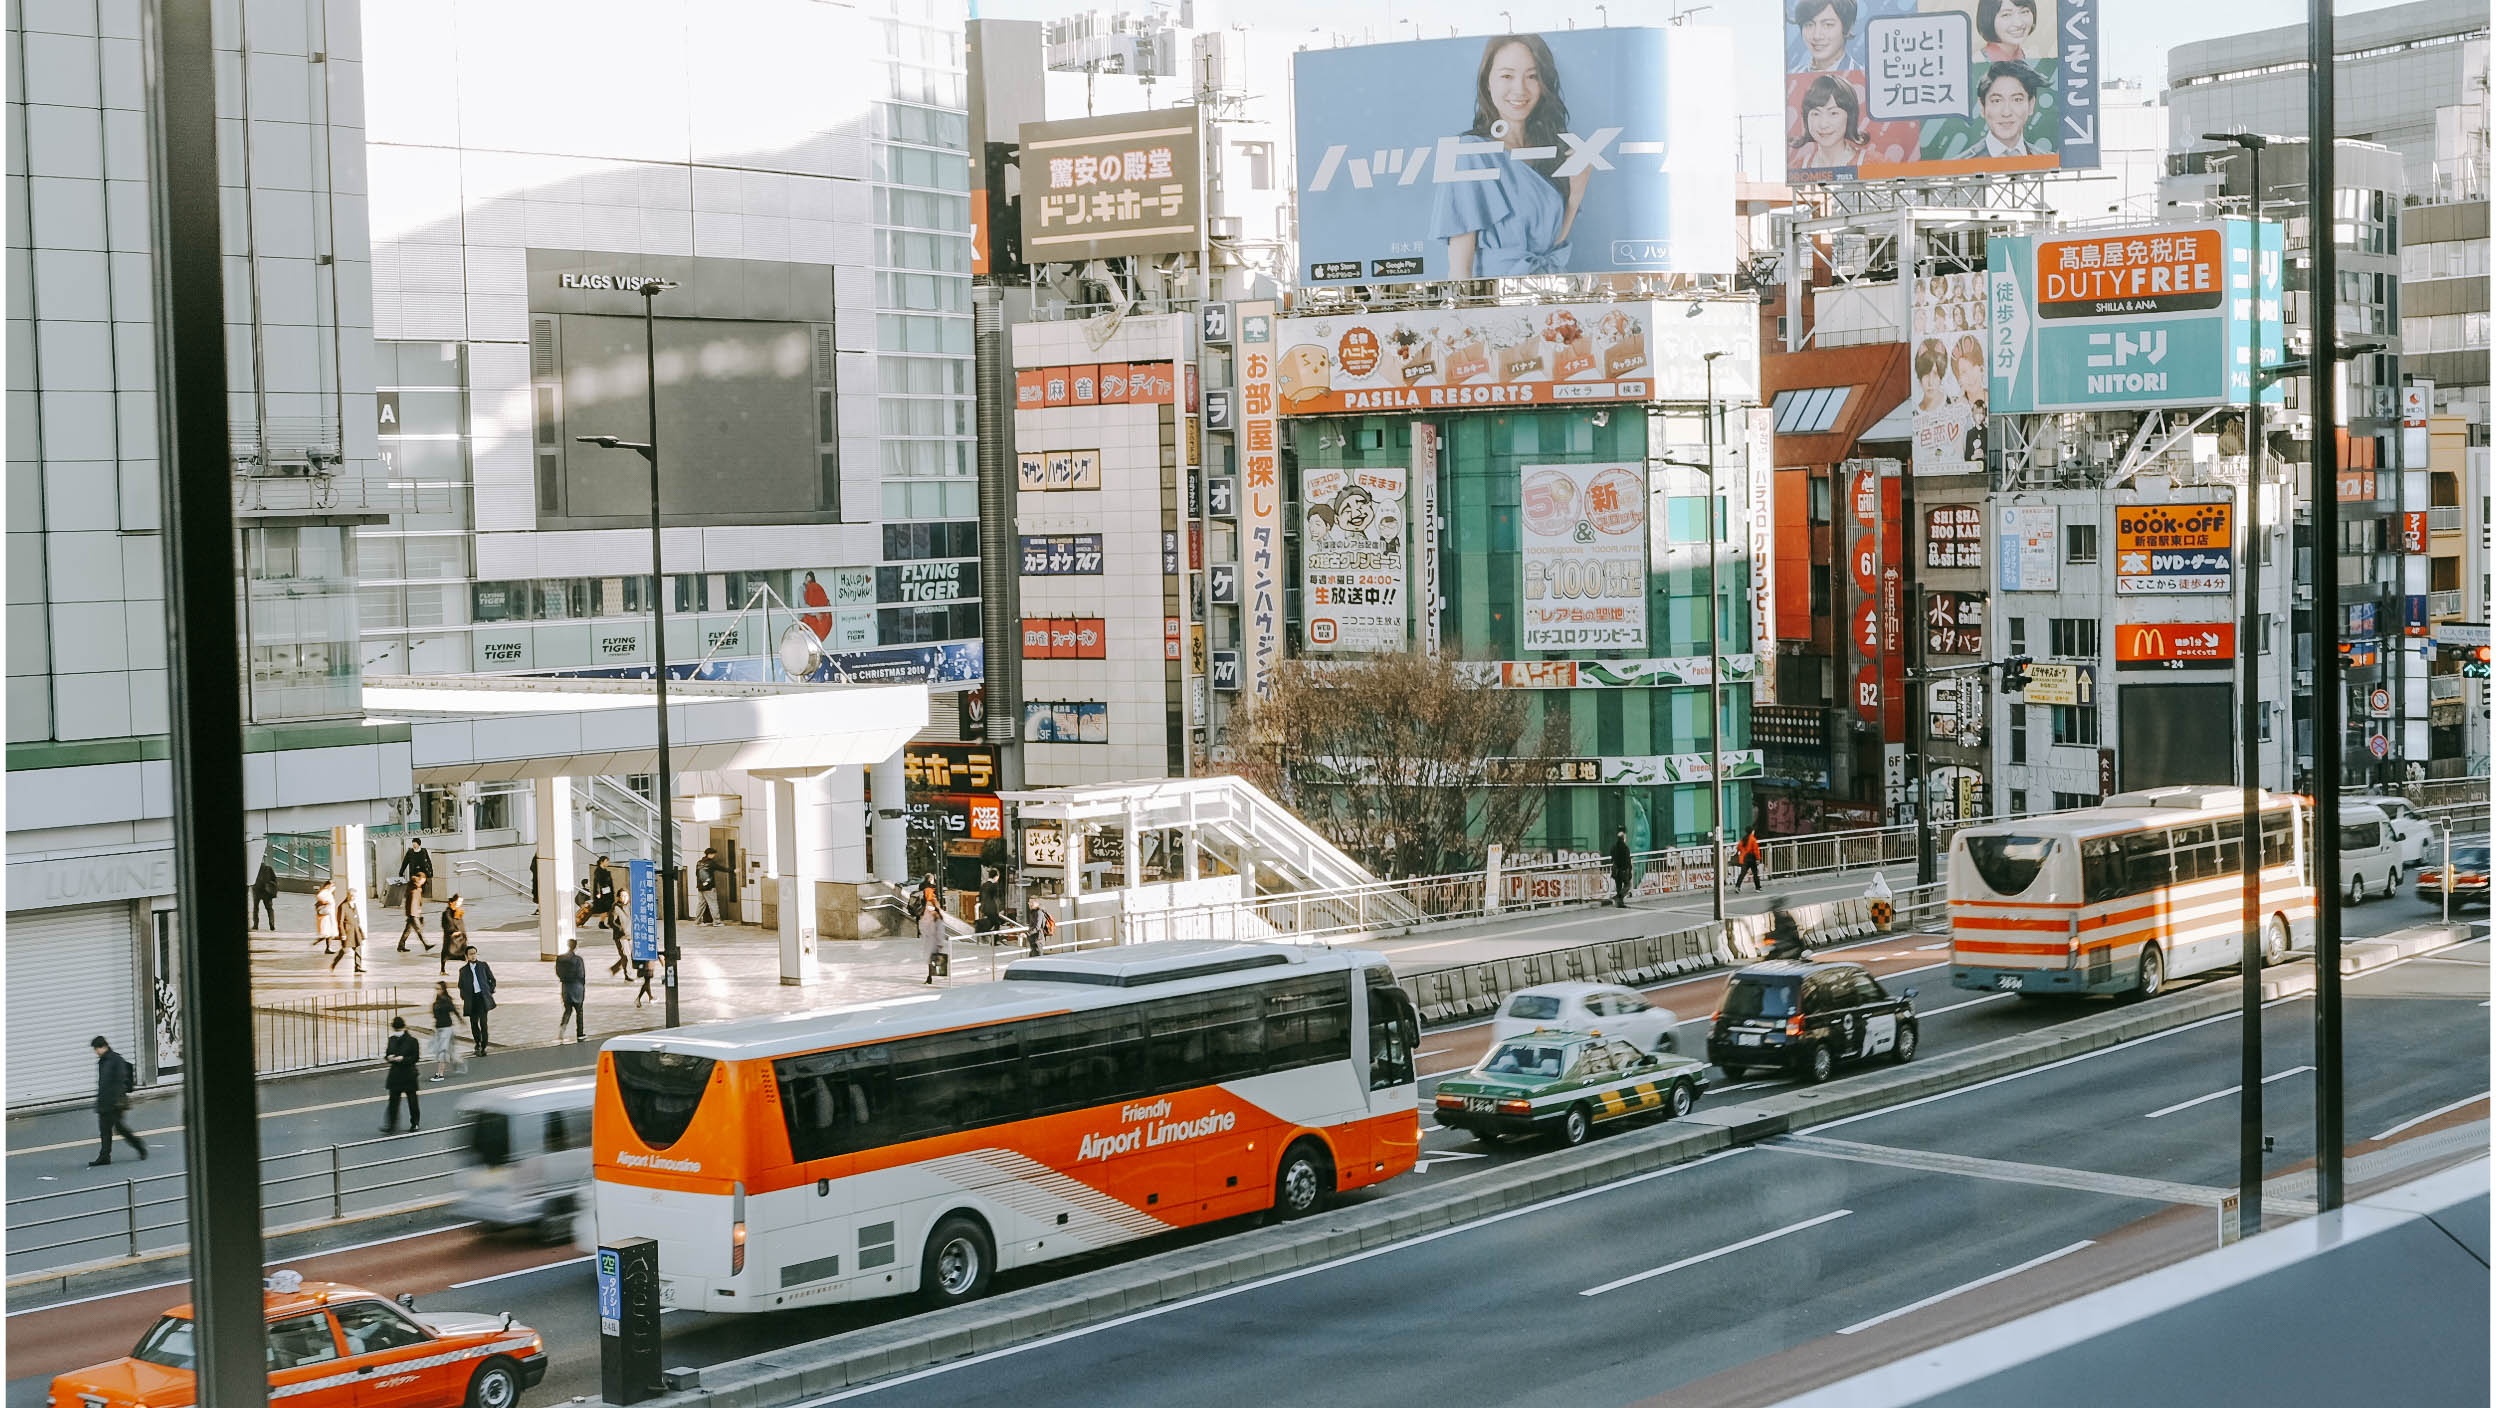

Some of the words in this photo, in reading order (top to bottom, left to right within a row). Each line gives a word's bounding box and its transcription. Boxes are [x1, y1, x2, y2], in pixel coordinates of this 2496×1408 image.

[1884, 84, 1955, 107] プロミス
[1048, 147, 1173, 188] 驚安の殿堂
[562, 273, 611, 289] FLAGS
[2095, 301, 2125, 313] SHILLA
[2126, 300, 2134, 311] &
[2135, 299, 2157, 310] ANA
[2087, 330, 2168, 367] ニトリ
[1511, 360, 1537, 373] バナナ
[1565, 359, 1589, 372] イチゴ
[1612, 356, 1644, 370] キャラメル
[2088, 372, 2167, 394] NITORI
[1345, 387, 1421, 408] PASELA
[1430, 384, 1534, 406] RESORTS
[379, 403, 397, 424] A
[1245, 353, 1275, 517] お部屋探し
[1022, 457, 1091, 484] タウンハウジング
[1934, 511, 1954, 524] SHI
[1956, 510, 1979, 523] SHA
[1573, 520, 1596, 544] &
[1931, 525, 1954, 538] HOO
[1956, 525, 1981, 538] KAH
[2135, 535, 2208, 547] 新宿駅東口店
[901, 563, 959, 582] FLYING
[1861, 552, 1876, 576] 6
[2121, 552, 2148, 574] 本
[2152, 554, 2230, 570] DVD・ゲーム
[1310, 575, 1354, 584] 毎週水曜日
[1549, 558, 1604, 599] 100
[900, 581, 959, 601] TIGER
[1540, 607, 1624, 622] レア台の聖地
[1929, 595, 1954, 626] 水
[1342, 616, 1400, 626] ニコニコ生放送
[602, 636, 636, 645] FLYING
[708, 631, 738, 640] FLYING
[708, 638, 738, 647] TIGER
[484, 650, 521, 660] TIGER
[485, 643, 521, 652] FLYING
[602, 643, 636, 653] TIGER
[859, 668, 906, 680] CHRISTMAS
[906, 666, 926, 676] 2018
[2171, 660, 2183, 668] 24
[1860, 682, 1878, 706] B2
[1039, 730, 1051, 740] 3F
[1888, 756, 1900, 767] 6F
[904, 803, 930, 813] LOT
[47, 860, 168, 900] LUMINE
[1121, 1099, 1172, 1124] Friendly
[1078, 1125, 1142, 1162] Airport
[1146, 1109, 1236, 1146] Limousine
[616, 1150, 647, 1168] Airport
[648, 1156, 702, 1174] Limousine
[602, 1255, 616, 1276] 空
[601, 1286, 609, 1316] プール
[609, 1277, 617, 1317] タクシー
